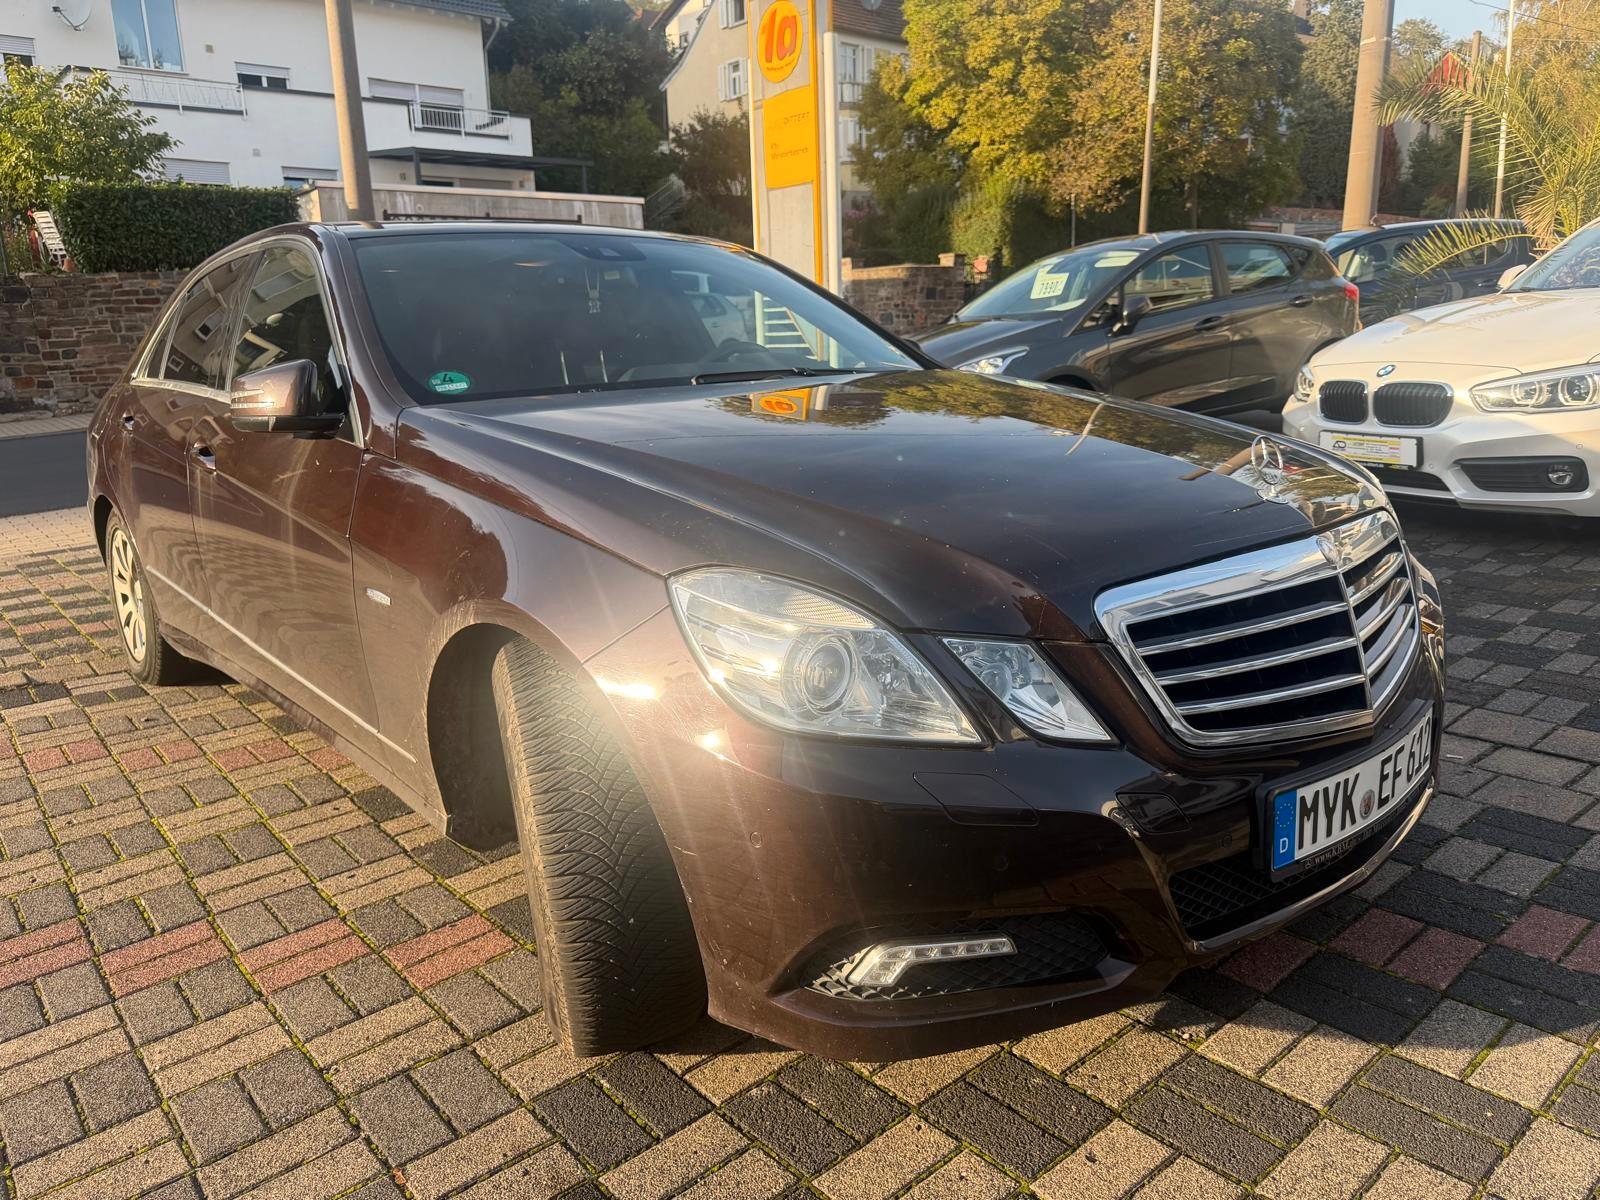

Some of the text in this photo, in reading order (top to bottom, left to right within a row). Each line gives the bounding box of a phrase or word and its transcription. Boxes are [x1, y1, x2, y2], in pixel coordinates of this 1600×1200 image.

[442, 373, 454, 383] 4
[1298, 772, 1360, 850] MYK
[1377, 744, 1406, 810] EF
[1406, 716, 1432, 785] 612
[1279, 837, 1289, 854] D
